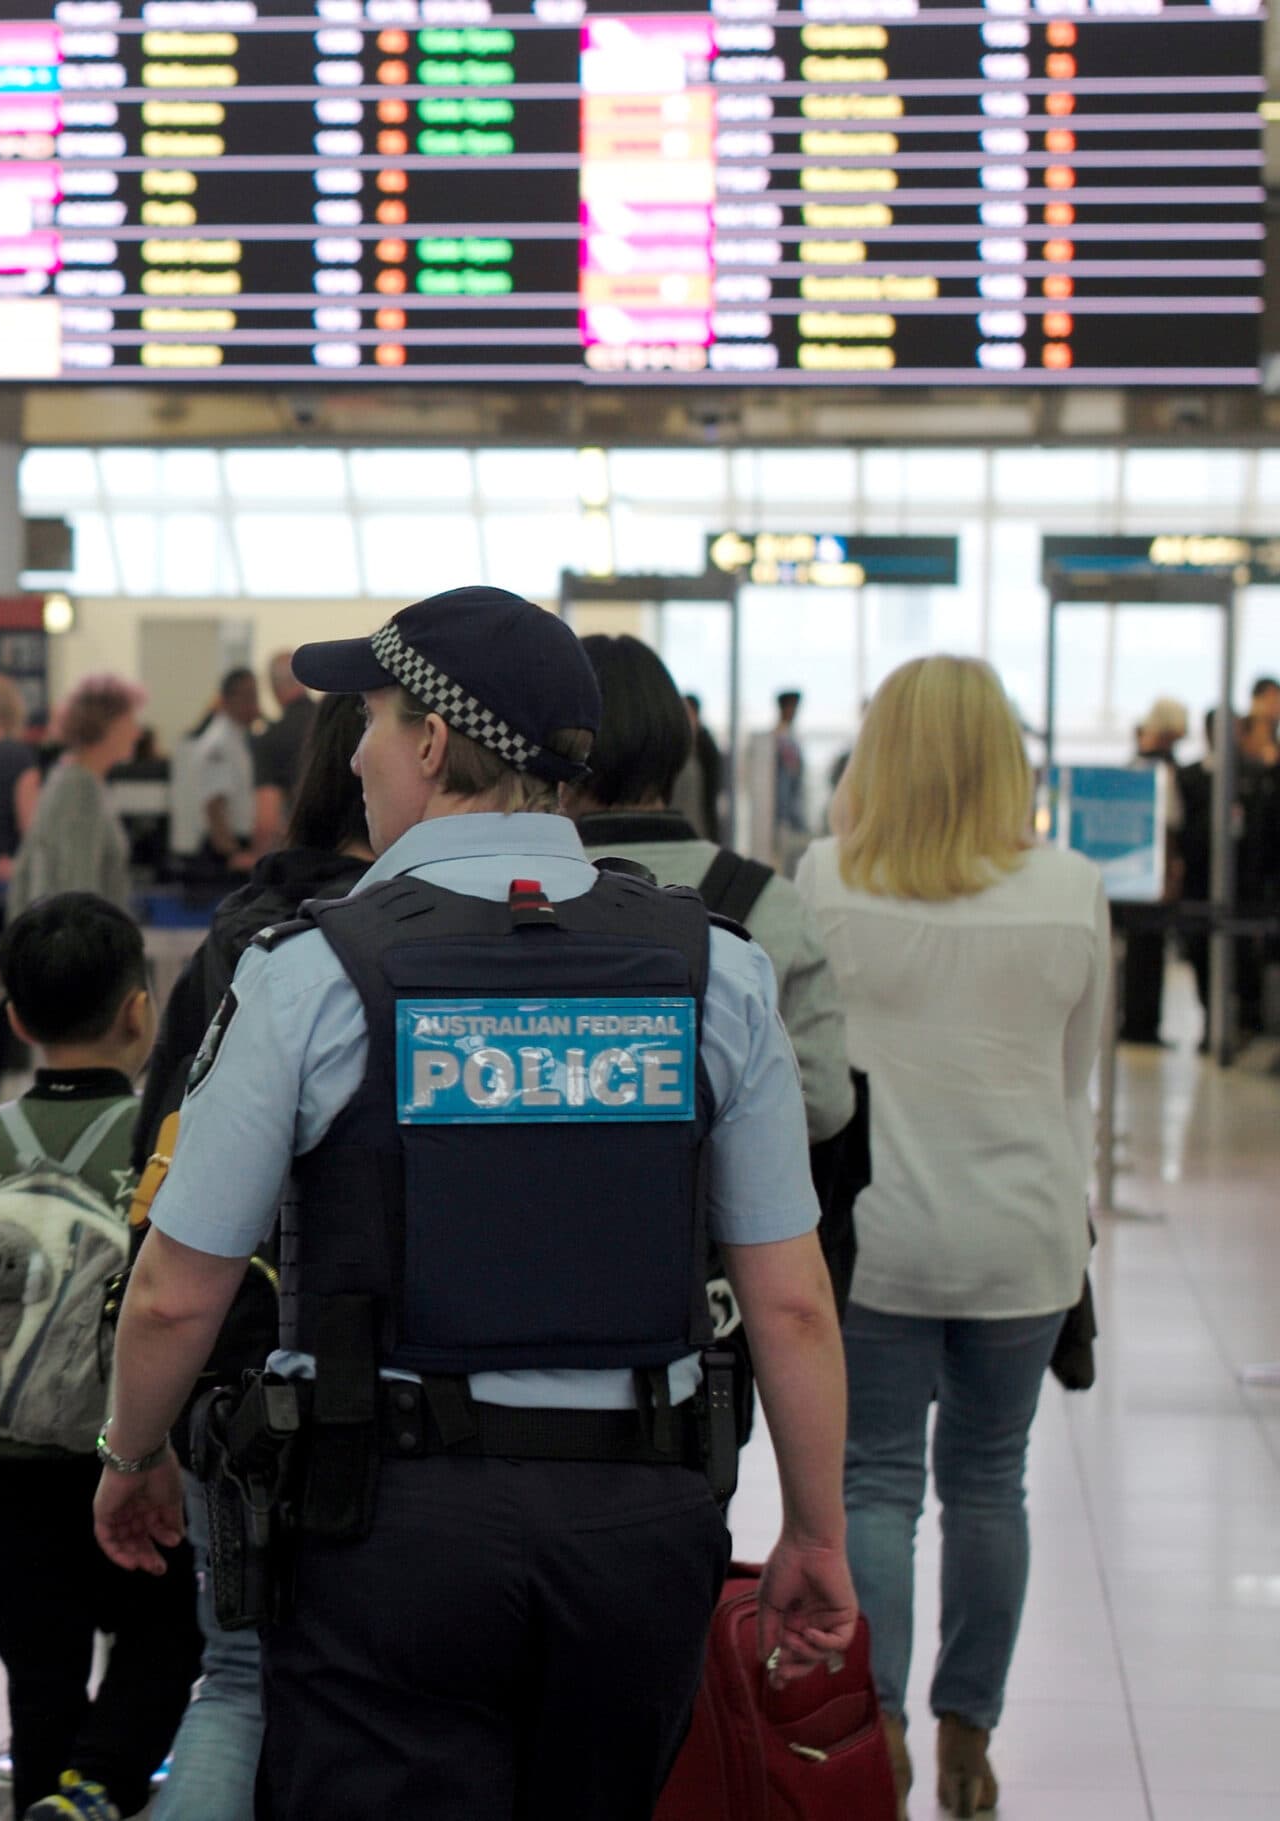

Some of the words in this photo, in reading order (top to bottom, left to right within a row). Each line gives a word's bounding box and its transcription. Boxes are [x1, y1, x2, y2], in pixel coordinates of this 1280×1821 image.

[414, 1015, 570, 1037] AUSTRALIAN
[575, 1015, 683, 1036] FEDERAL
[413, 1047, 683, 1108] POLICE
